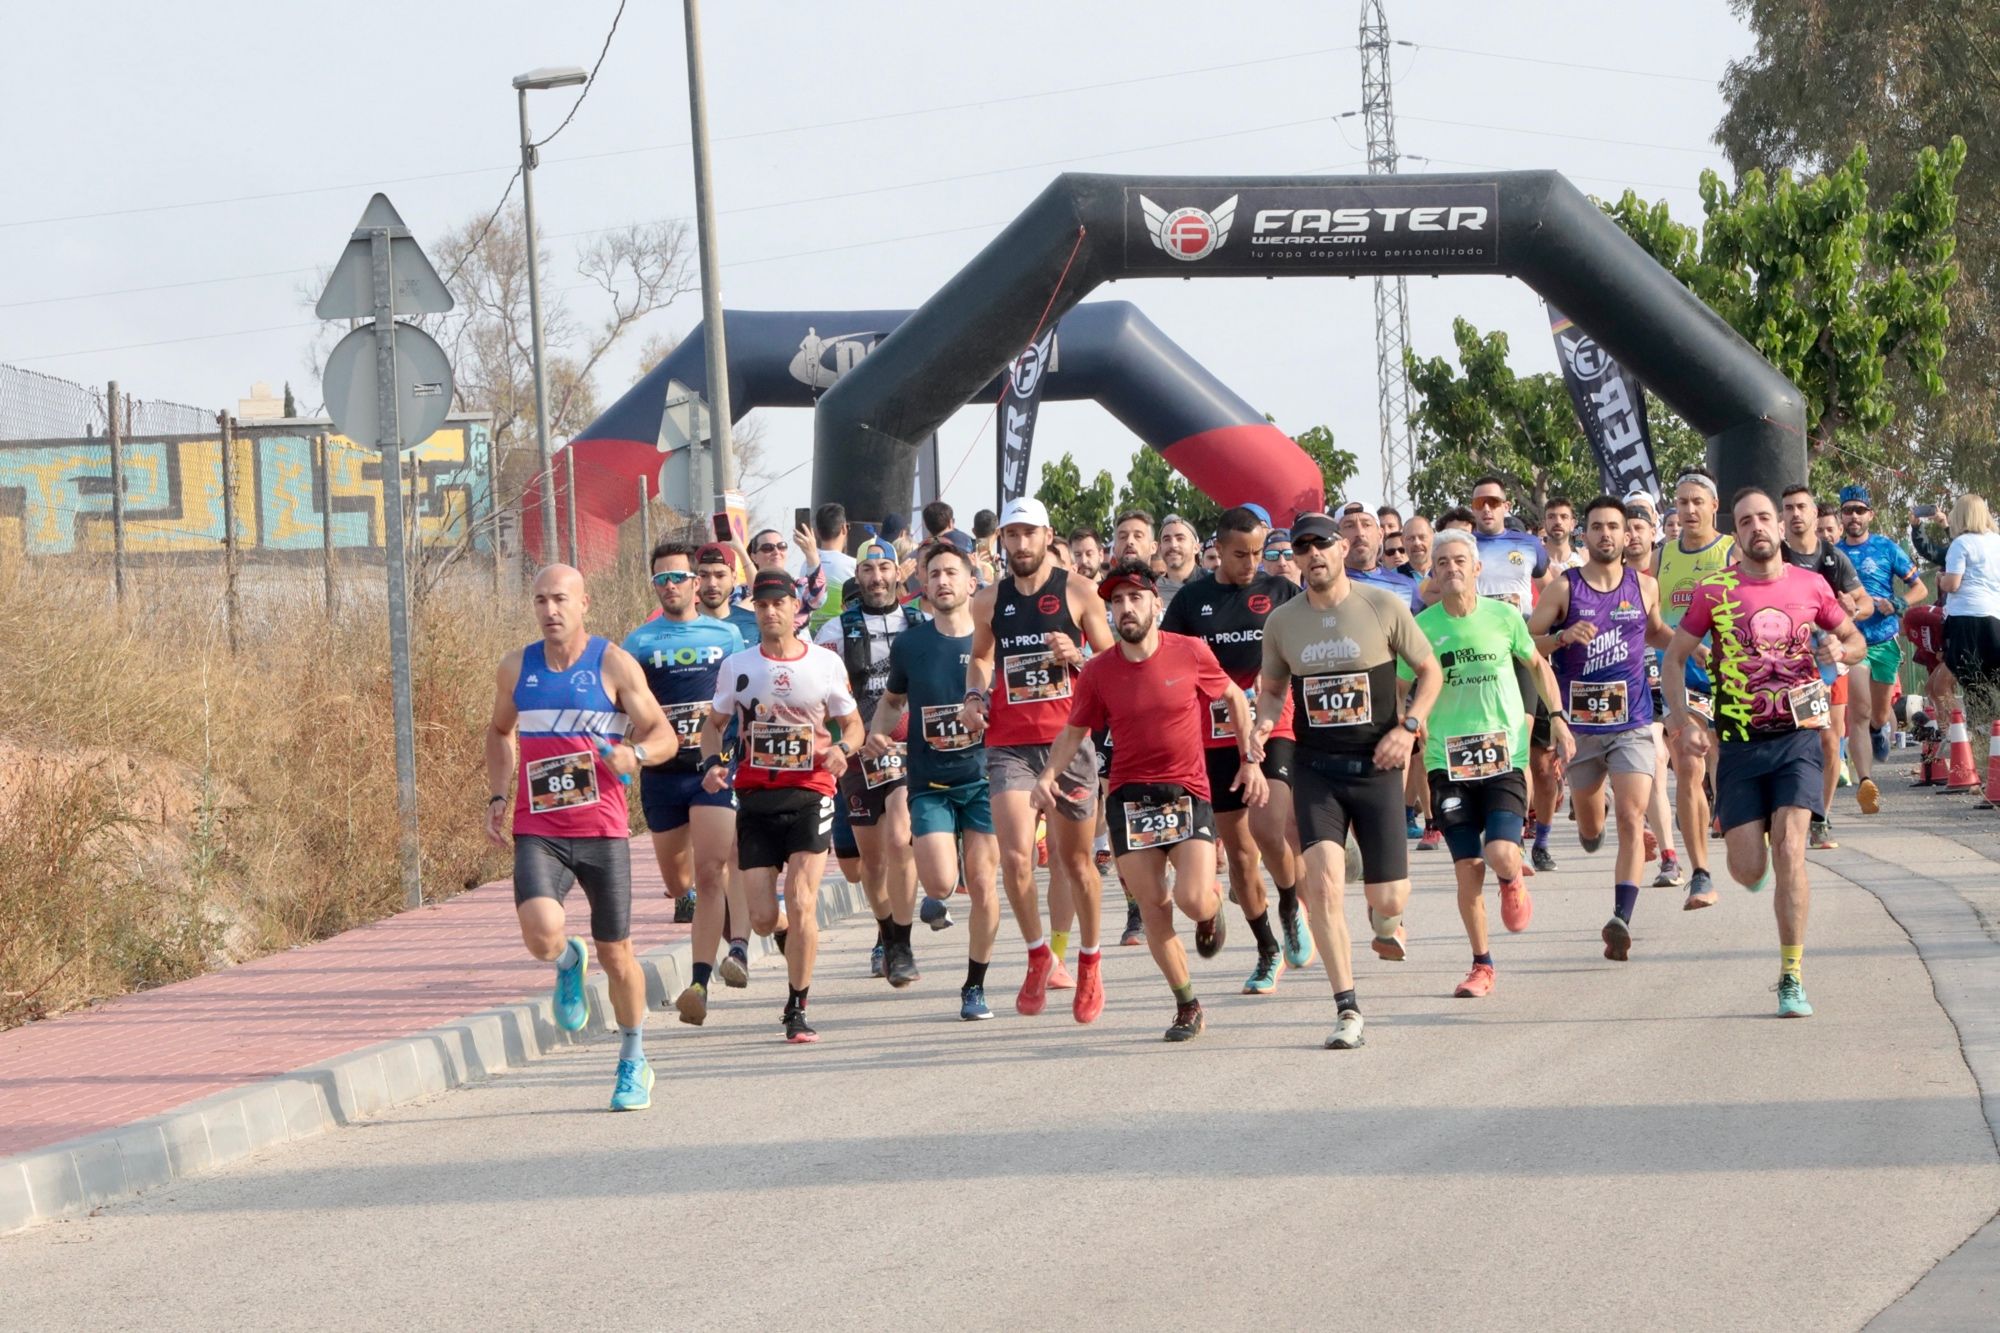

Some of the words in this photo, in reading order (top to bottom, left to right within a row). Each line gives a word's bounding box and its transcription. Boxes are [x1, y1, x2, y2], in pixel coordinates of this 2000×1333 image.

[1254, 206, 1488, 234] FASTER
[1251, 235, 1367, 245] WEAR.COM
[1251, 250, 1264, 259] tu
[1271, 250, 1302, 260] ropa
[1310, 249, 1378, 259] deportiva
[1384, 247, 1484, 259] personalizada
[1215, 629, 1263, 645] PROJEC
[1587, 625, 1623, 658] COME
[649, 646, 724, 669] HOPP
[1455, 648, 1475, 660] pan
[1458, 653, 1497, 664] moreno
[1582, 642, 1629, 676] MILLAS
[1025, 669, 1050, 686] 53
[1649, 665, 1659, 677] 8
[1318, 692, 1356, 711] 107
[1587, 697, 1610, 712] 95
[1810, 697, 1829, 716] 96
[677, 718, 700, 734] 57
[764, 739, 801, 755] 115
[872, 755, 901, 771] 149
[1461, 748, 1498, 766] 219
[548, 773, 576, 793] 86
[1140, 813, 1179, 832] 239
